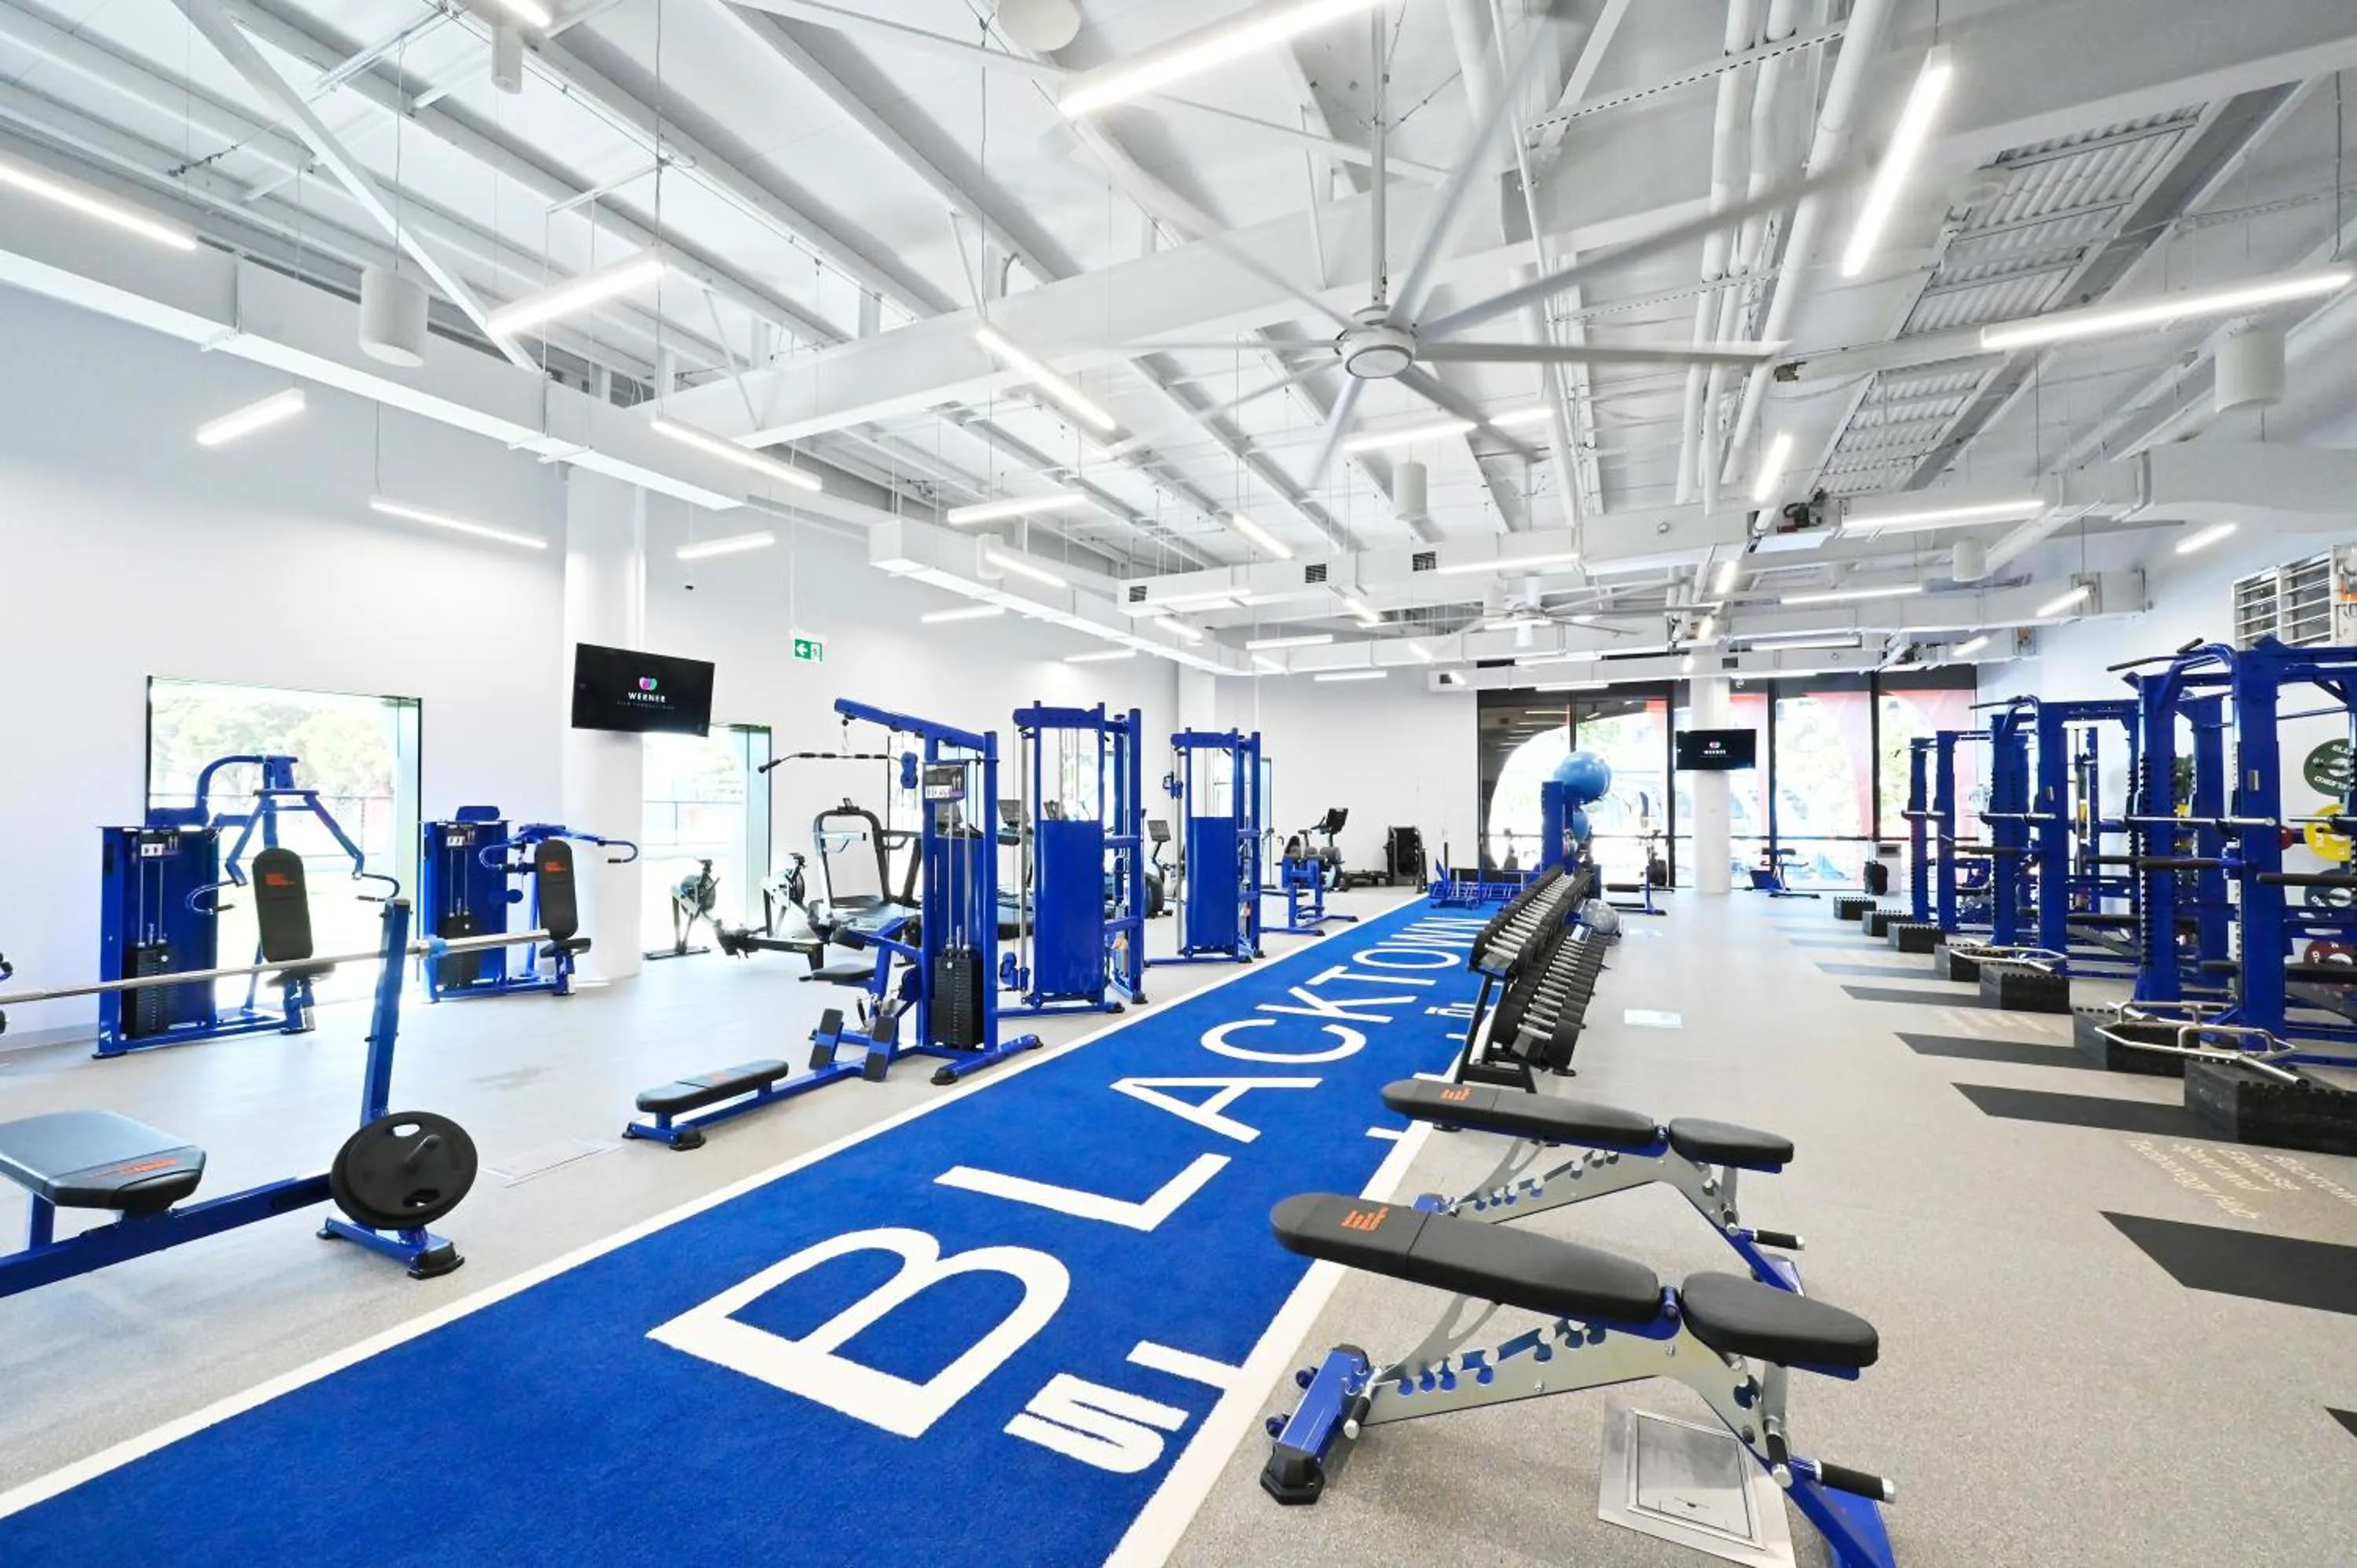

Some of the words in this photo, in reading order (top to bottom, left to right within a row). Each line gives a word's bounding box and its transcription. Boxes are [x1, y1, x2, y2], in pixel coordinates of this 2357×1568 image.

[628, 692, 665, 702] WERNER
[645, 918, 1490, 1438] BLACKTOWN
[1003, 1373, 1189, 1473] 5
